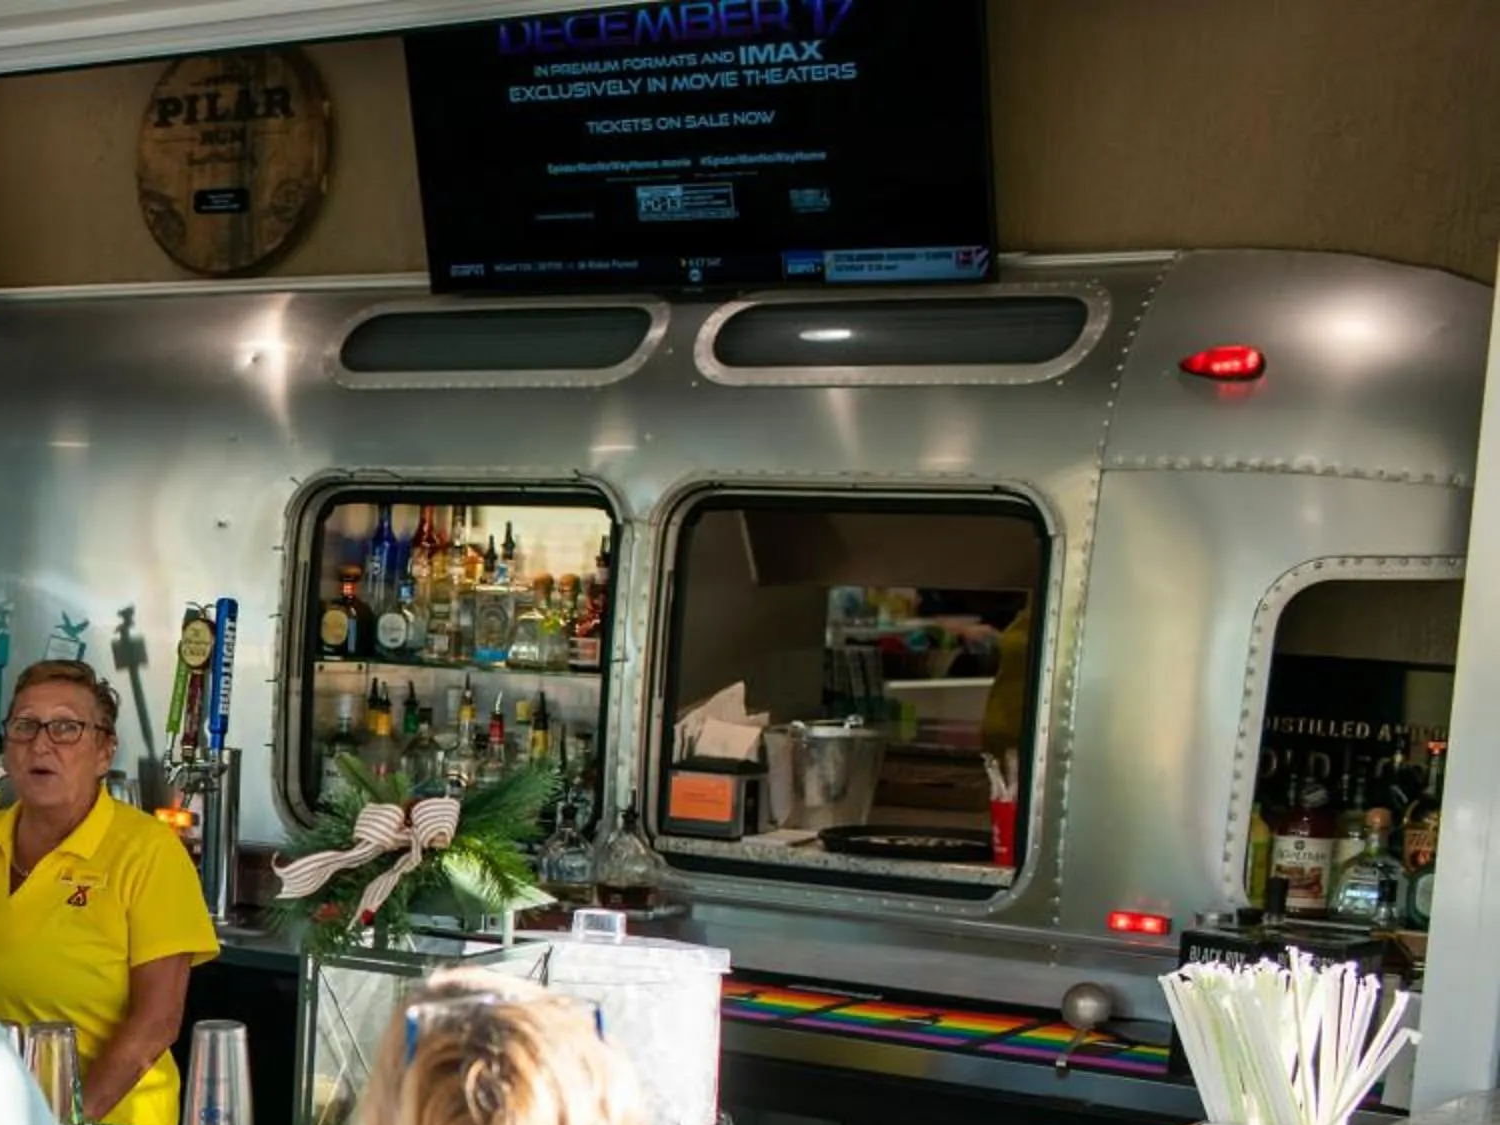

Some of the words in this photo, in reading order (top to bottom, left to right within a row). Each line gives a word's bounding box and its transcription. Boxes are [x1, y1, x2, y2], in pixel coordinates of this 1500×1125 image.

[497, 0, 791, 56] DECEMBER
[803, 0, 855, 37] 17
[534, 64, 547, 77] IN
[550, 58, 620, 76] PREMIUM
[622, 53, 698, 72] FORMATS
[700, 50, 735, 66] AND
[739, 40, 823, 66] IMAX
[509, 78, 644, 103] EXCLUSIVELY
[646, 75, 668, 94] IN
[671, 68, 740, 92] MOVIE
[743, 61, 858, 86] THEATERS
[154, 88, 295, 127] PILAR
[585, 117, 654, 135] TICKETS
[656, 116, 682, 131] ON
[684, 113, 730, 130] SALE
[732, 110, 777, 127] NOW
[221, 617, 236, 674] LIGHT
[217, 675, 232, 715] BUD
[1188, 944, 1223, 963] BLACK
